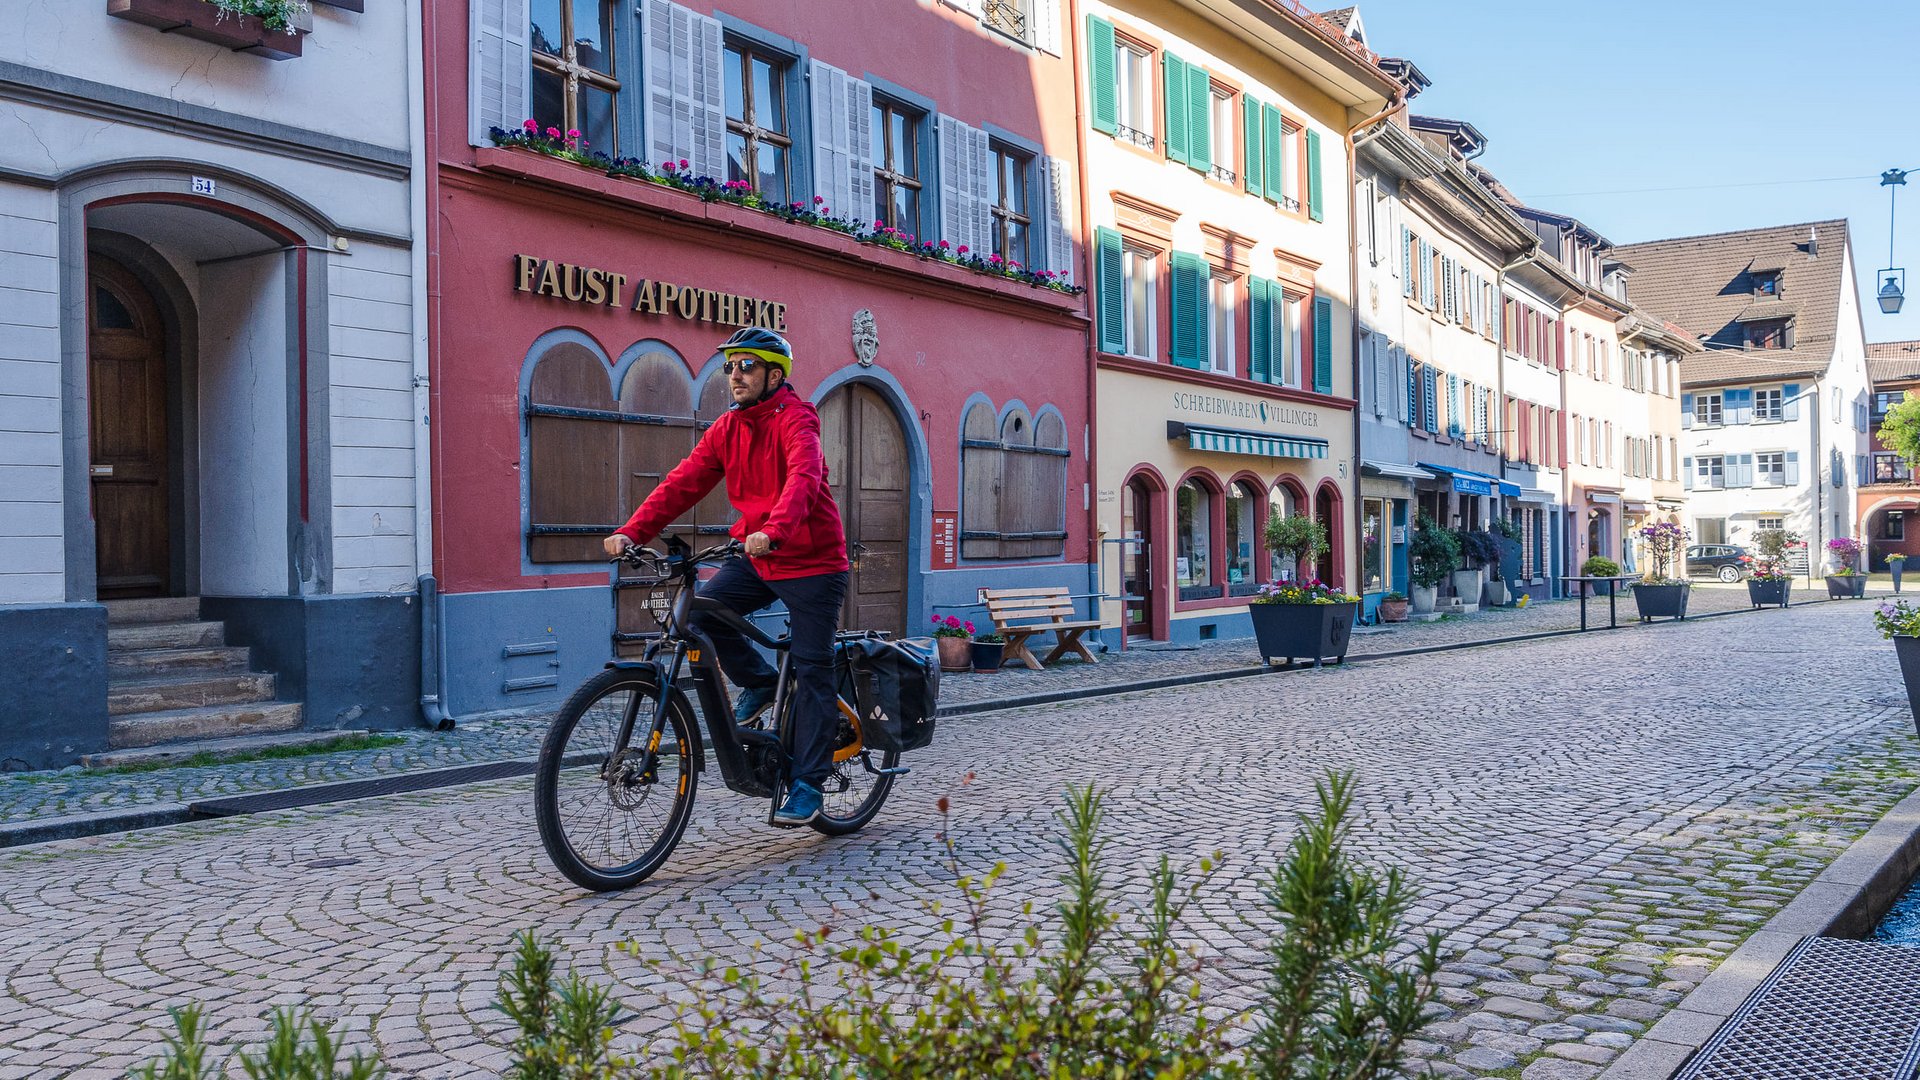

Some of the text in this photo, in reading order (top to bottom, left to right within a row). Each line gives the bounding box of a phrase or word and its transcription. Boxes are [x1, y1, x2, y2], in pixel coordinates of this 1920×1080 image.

[196, 179, 212, 193] 54
[514, 254, 788, 333] FAUST APOTHEKE
[1174, 392, 1319, 428] SCHREIBWAREN VILLINGER
[1338, 463, 1348, 480] 50
